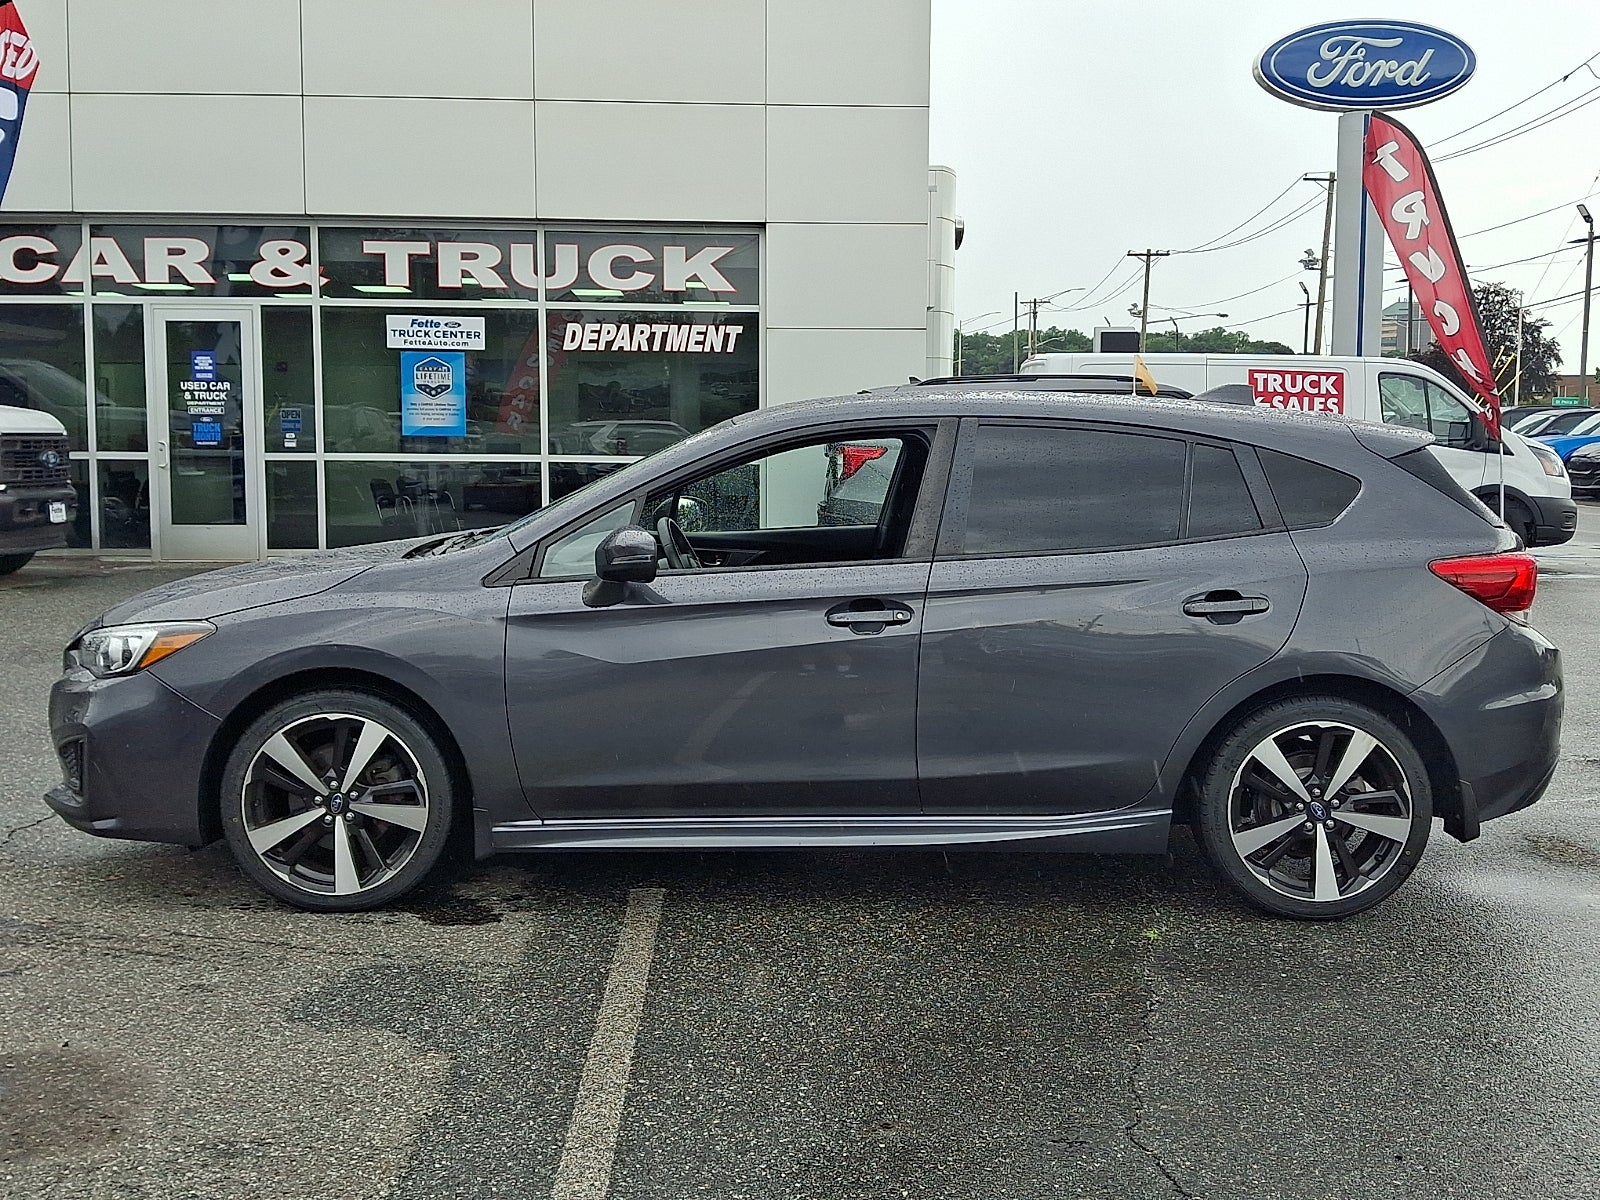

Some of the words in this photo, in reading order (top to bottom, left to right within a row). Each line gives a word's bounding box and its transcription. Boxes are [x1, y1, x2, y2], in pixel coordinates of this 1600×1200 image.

[1306, 35, 1435, 88] Ford
[0, 235, 216, 284] CAR
[250, 240, 330, 287] &
[362, 240, 737, 293] TRUCK
[410, 319, 441, 328] Fette
[391, 329, 431, 339] TRUCK
[434, 330, 481, 340] CENTER
[562, 322, 743, 353] DEPARTMENT
[403, 339, 469, 347] FetteAuto.com
[415, 372, 451, 381] LIFETIME
[180, 381, 207, 391] USED
[209, 382, 231, 391] CAR
[1253, 372, 1339, 395] TRUCK
[184, 392, 191, 400] &
[194, 392, 227, 400] TRUCK
[1272, 395, 1339, 415] SALES
[281, 410, 300, 418] OPEN
